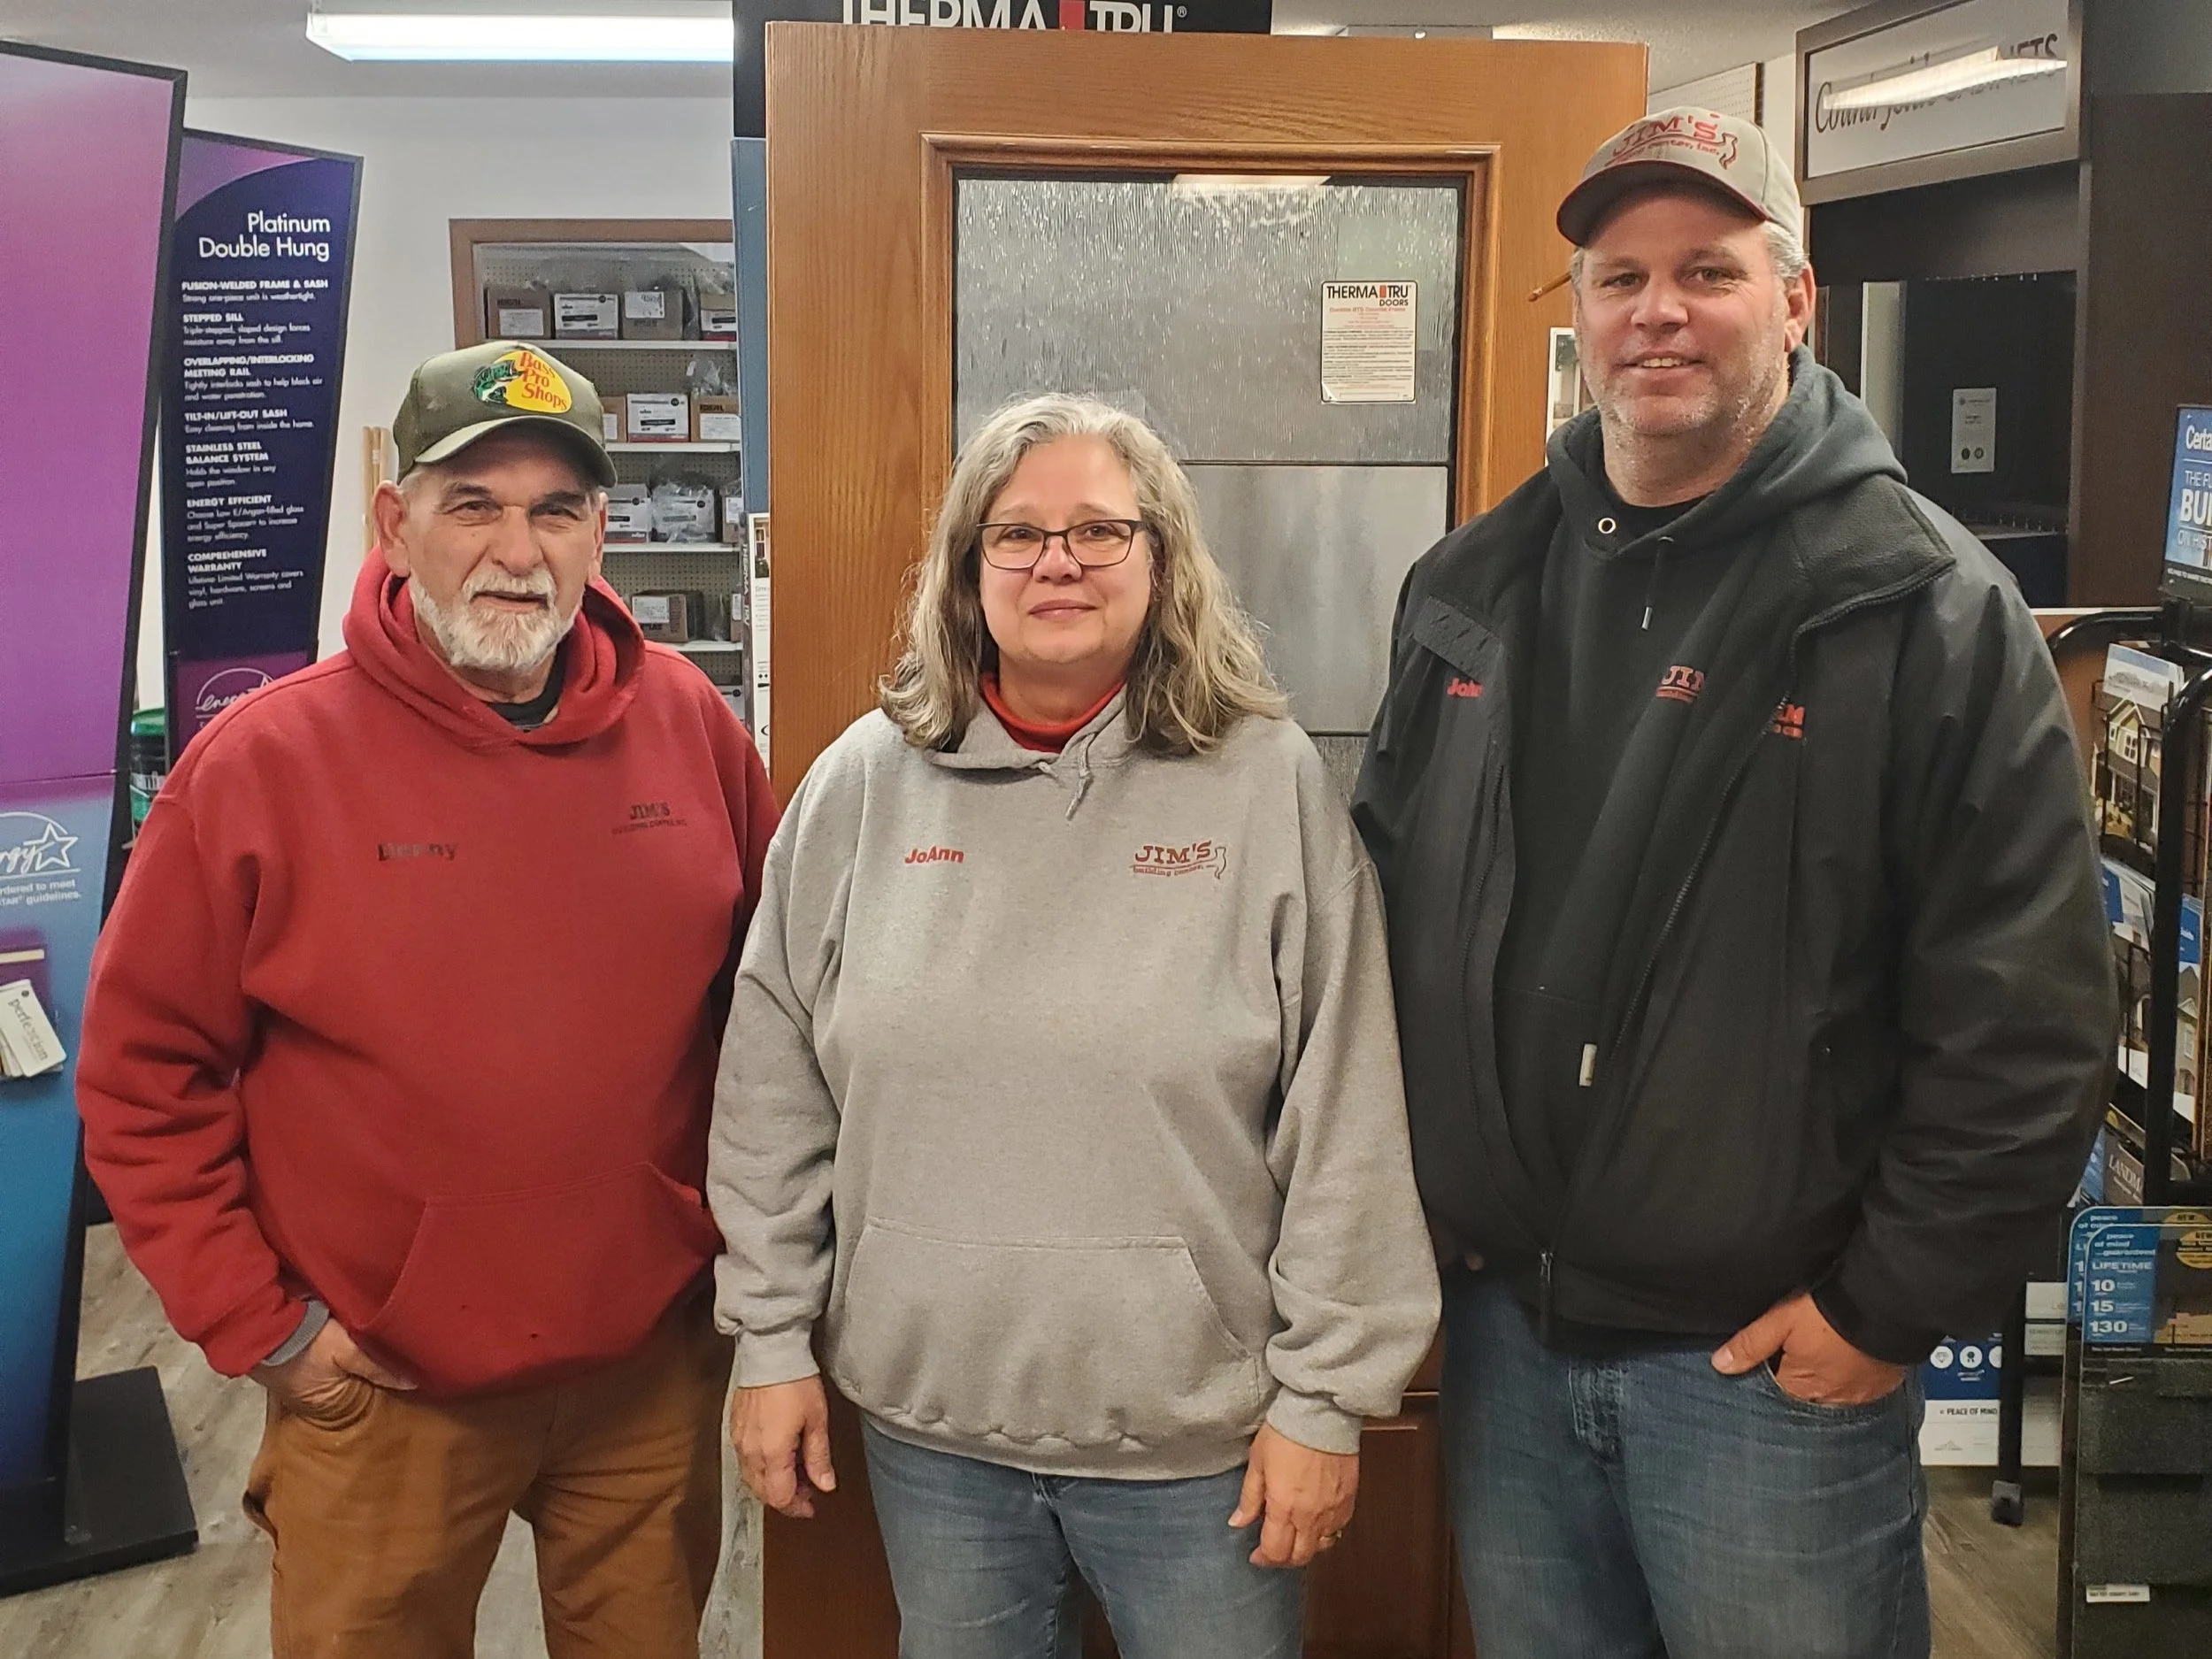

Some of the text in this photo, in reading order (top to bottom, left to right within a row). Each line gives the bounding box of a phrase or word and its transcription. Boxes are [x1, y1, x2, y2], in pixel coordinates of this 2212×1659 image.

[1613, 115, 1717, 157] JIM'S
[248, 211, 330, 234] Platinum
[199, 234, 329, 261] Double Hung
[182, 280, 257, 290] FUSION-WELDED
[260, 280, 289, 289] FRAME
[1327, 286, 1409, 298] THERMA TRU
[520, 352, 555, 378] Bass
[184, 368, 226, 377] MEETING
[522, 370, 549, 387] Pro
[522, 382, 567, 410] Shops
[186, 443, 234, 452] STAINLESS
[186, 453, 269, 465] BALANCE SYSTEM
[187, 495, 272, 507] ENERGY EFFICIENT
[188, 549, 266, 561] COMPREHENSIVE
[188, 563, 242, 573] WARRANTY
[905, 845, 964, 864] JoAnn
[1135, 841, 1211, 864] JIM'S
[50, 879, 76, 889] meet
[2092, 1279, 2116, 1292] 10
[2090, 1301, 2114, 1312] 15
[2089, 1321, 2127, 1333] 130
